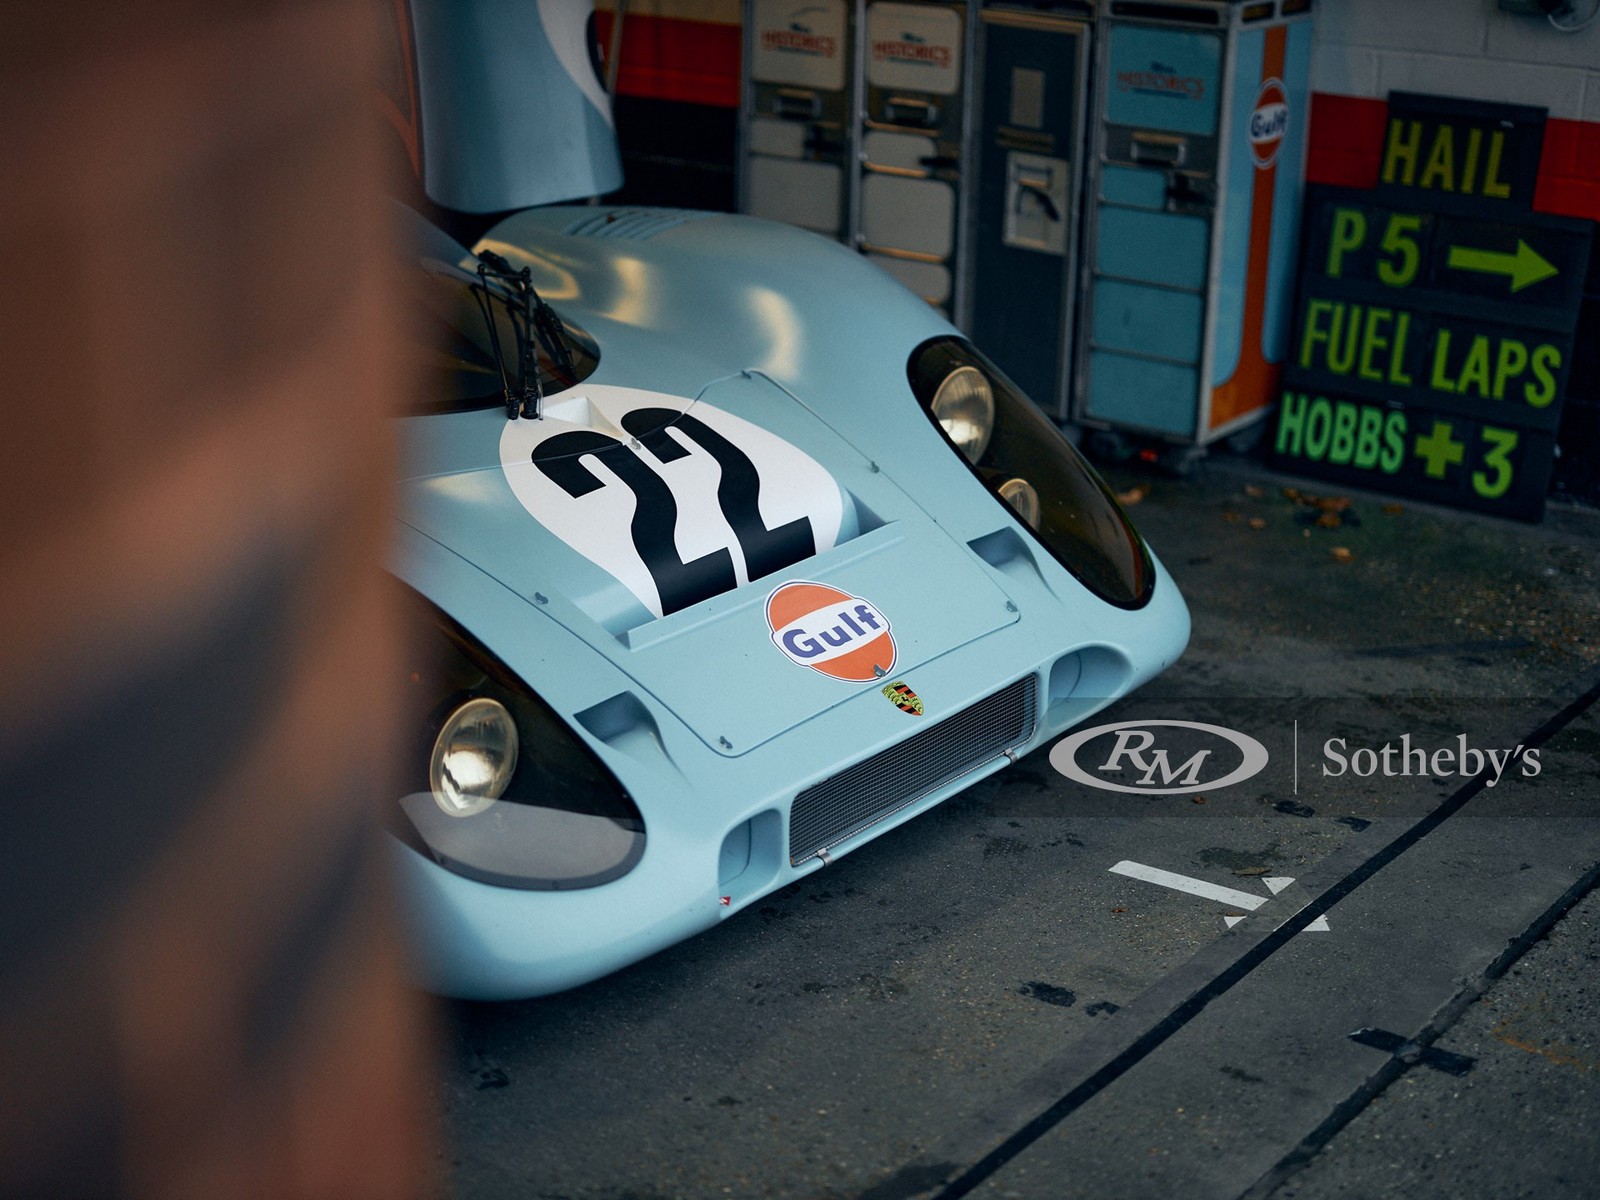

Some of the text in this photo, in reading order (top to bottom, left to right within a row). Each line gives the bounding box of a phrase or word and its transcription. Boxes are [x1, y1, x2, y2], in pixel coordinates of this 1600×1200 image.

[1251, 108, 1288, 137] Gulf
[1382, 118, 1511, 199] HAIL
[1300, 298, 1562, 409] FUEL LAPS
[1275, 392, 1408, 475] HOBBS
[531, 407, 816, 617] 22
[782, 604, 882, 659] Gulf
